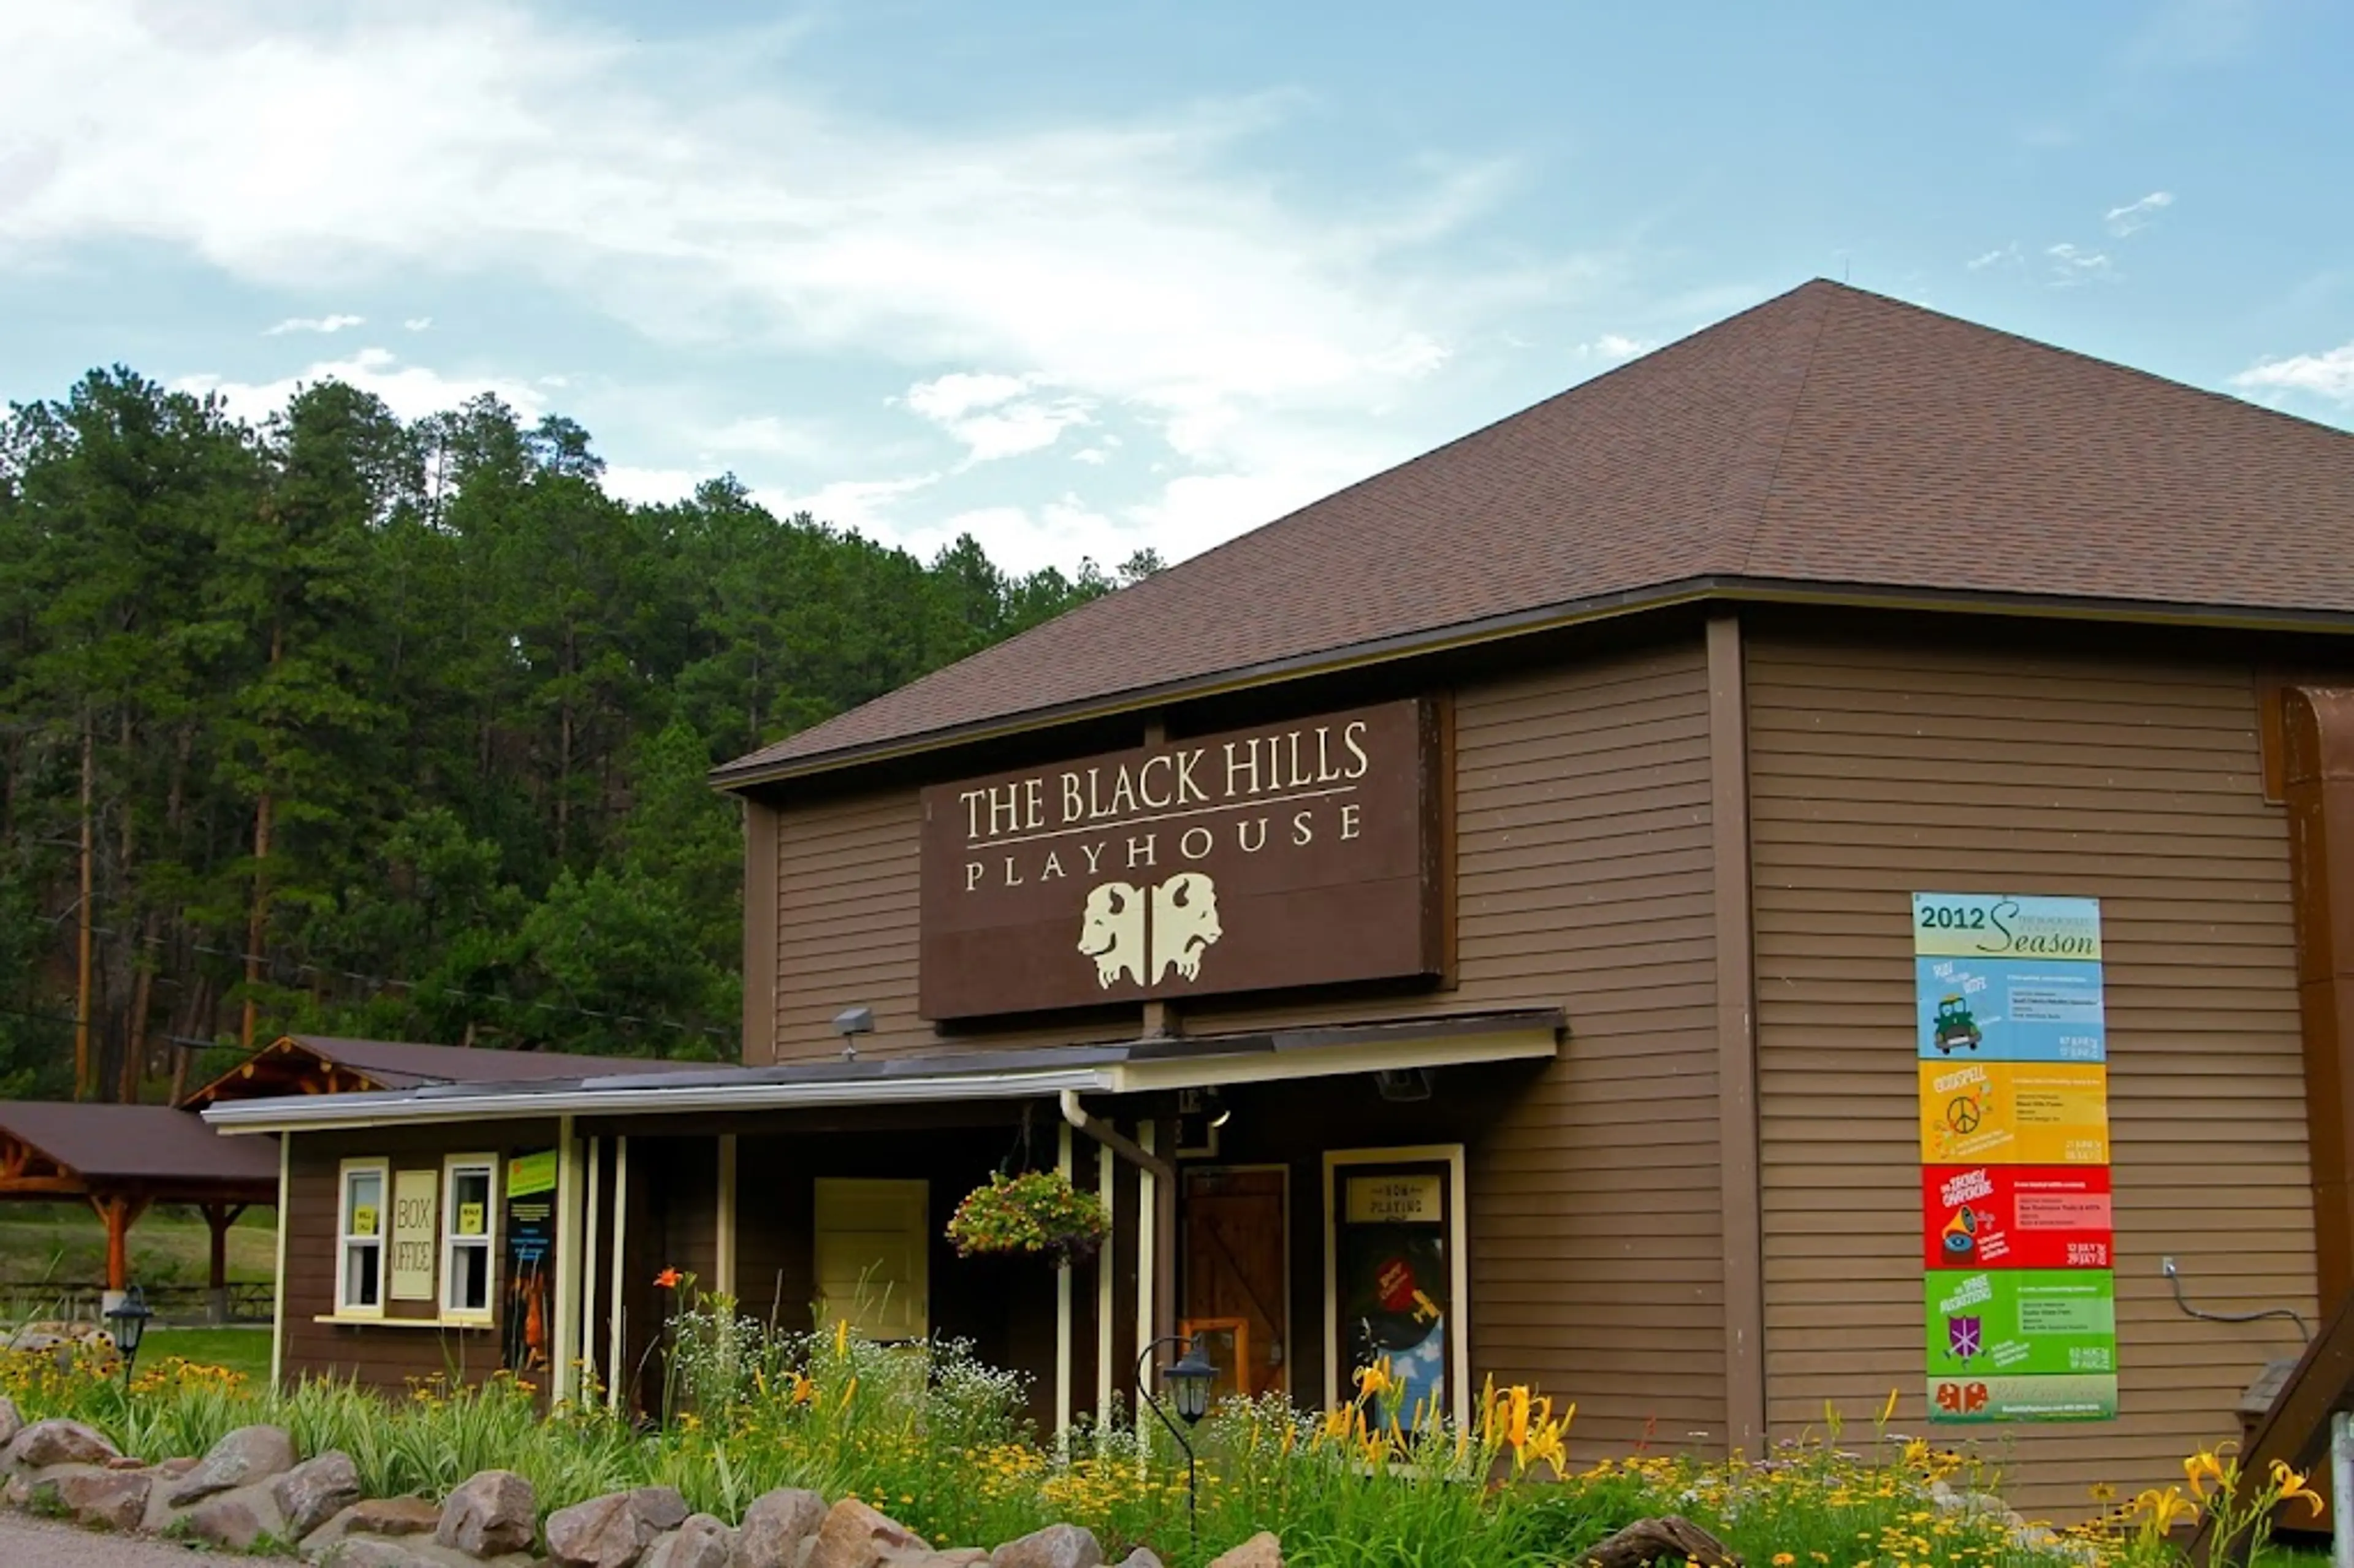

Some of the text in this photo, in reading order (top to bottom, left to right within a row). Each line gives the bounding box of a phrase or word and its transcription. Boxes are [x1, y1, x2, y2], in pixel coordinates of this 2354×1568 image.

[960, 721, 1369, 839] THE BLACK HILLS
[966, 804, 1361, 891] PLAYHOUSE
[1921, 906, 1985, 929] 2012
[1976, 900, 2095, 954] Season
[397, 1199, 431, 1228] BOX
[1370, 1200, 1422, 1214] PLAYING
[393, 1241, 431, 1272] OFFICE
